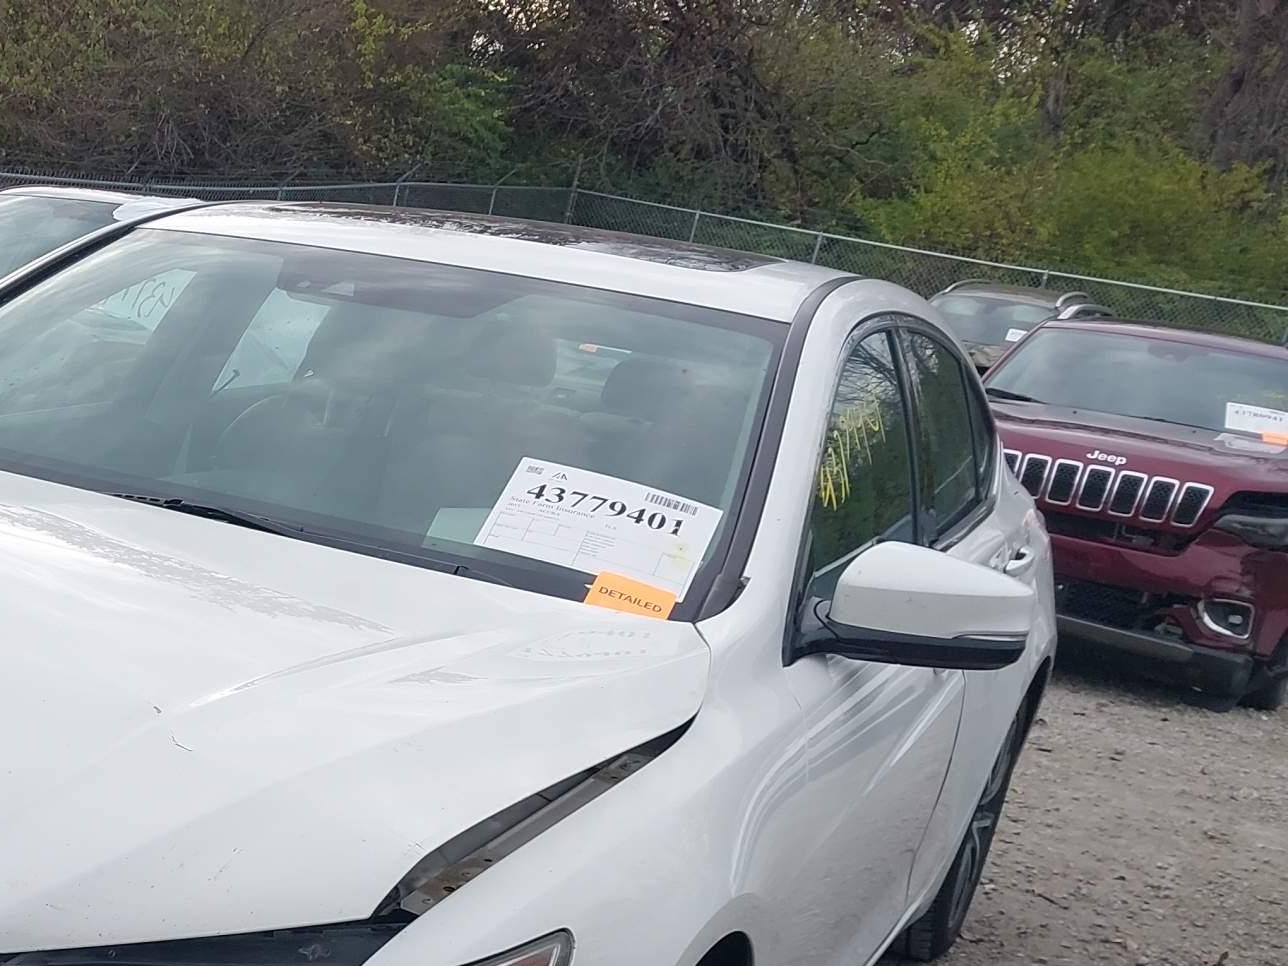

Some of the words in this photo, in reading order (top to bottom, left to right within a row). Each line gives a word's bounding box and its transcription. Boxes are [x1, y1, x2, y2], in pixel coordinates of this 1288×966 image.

[1086, 450, 1128, 466] Jeep
[511, 495, 531, 505] State
[532, 500, 554, 510] Farm
[556, 504, 596, 519] Insurance
[526, 483, 684, 537] 43779401
[598, 585, 662, 614] DETAILED
